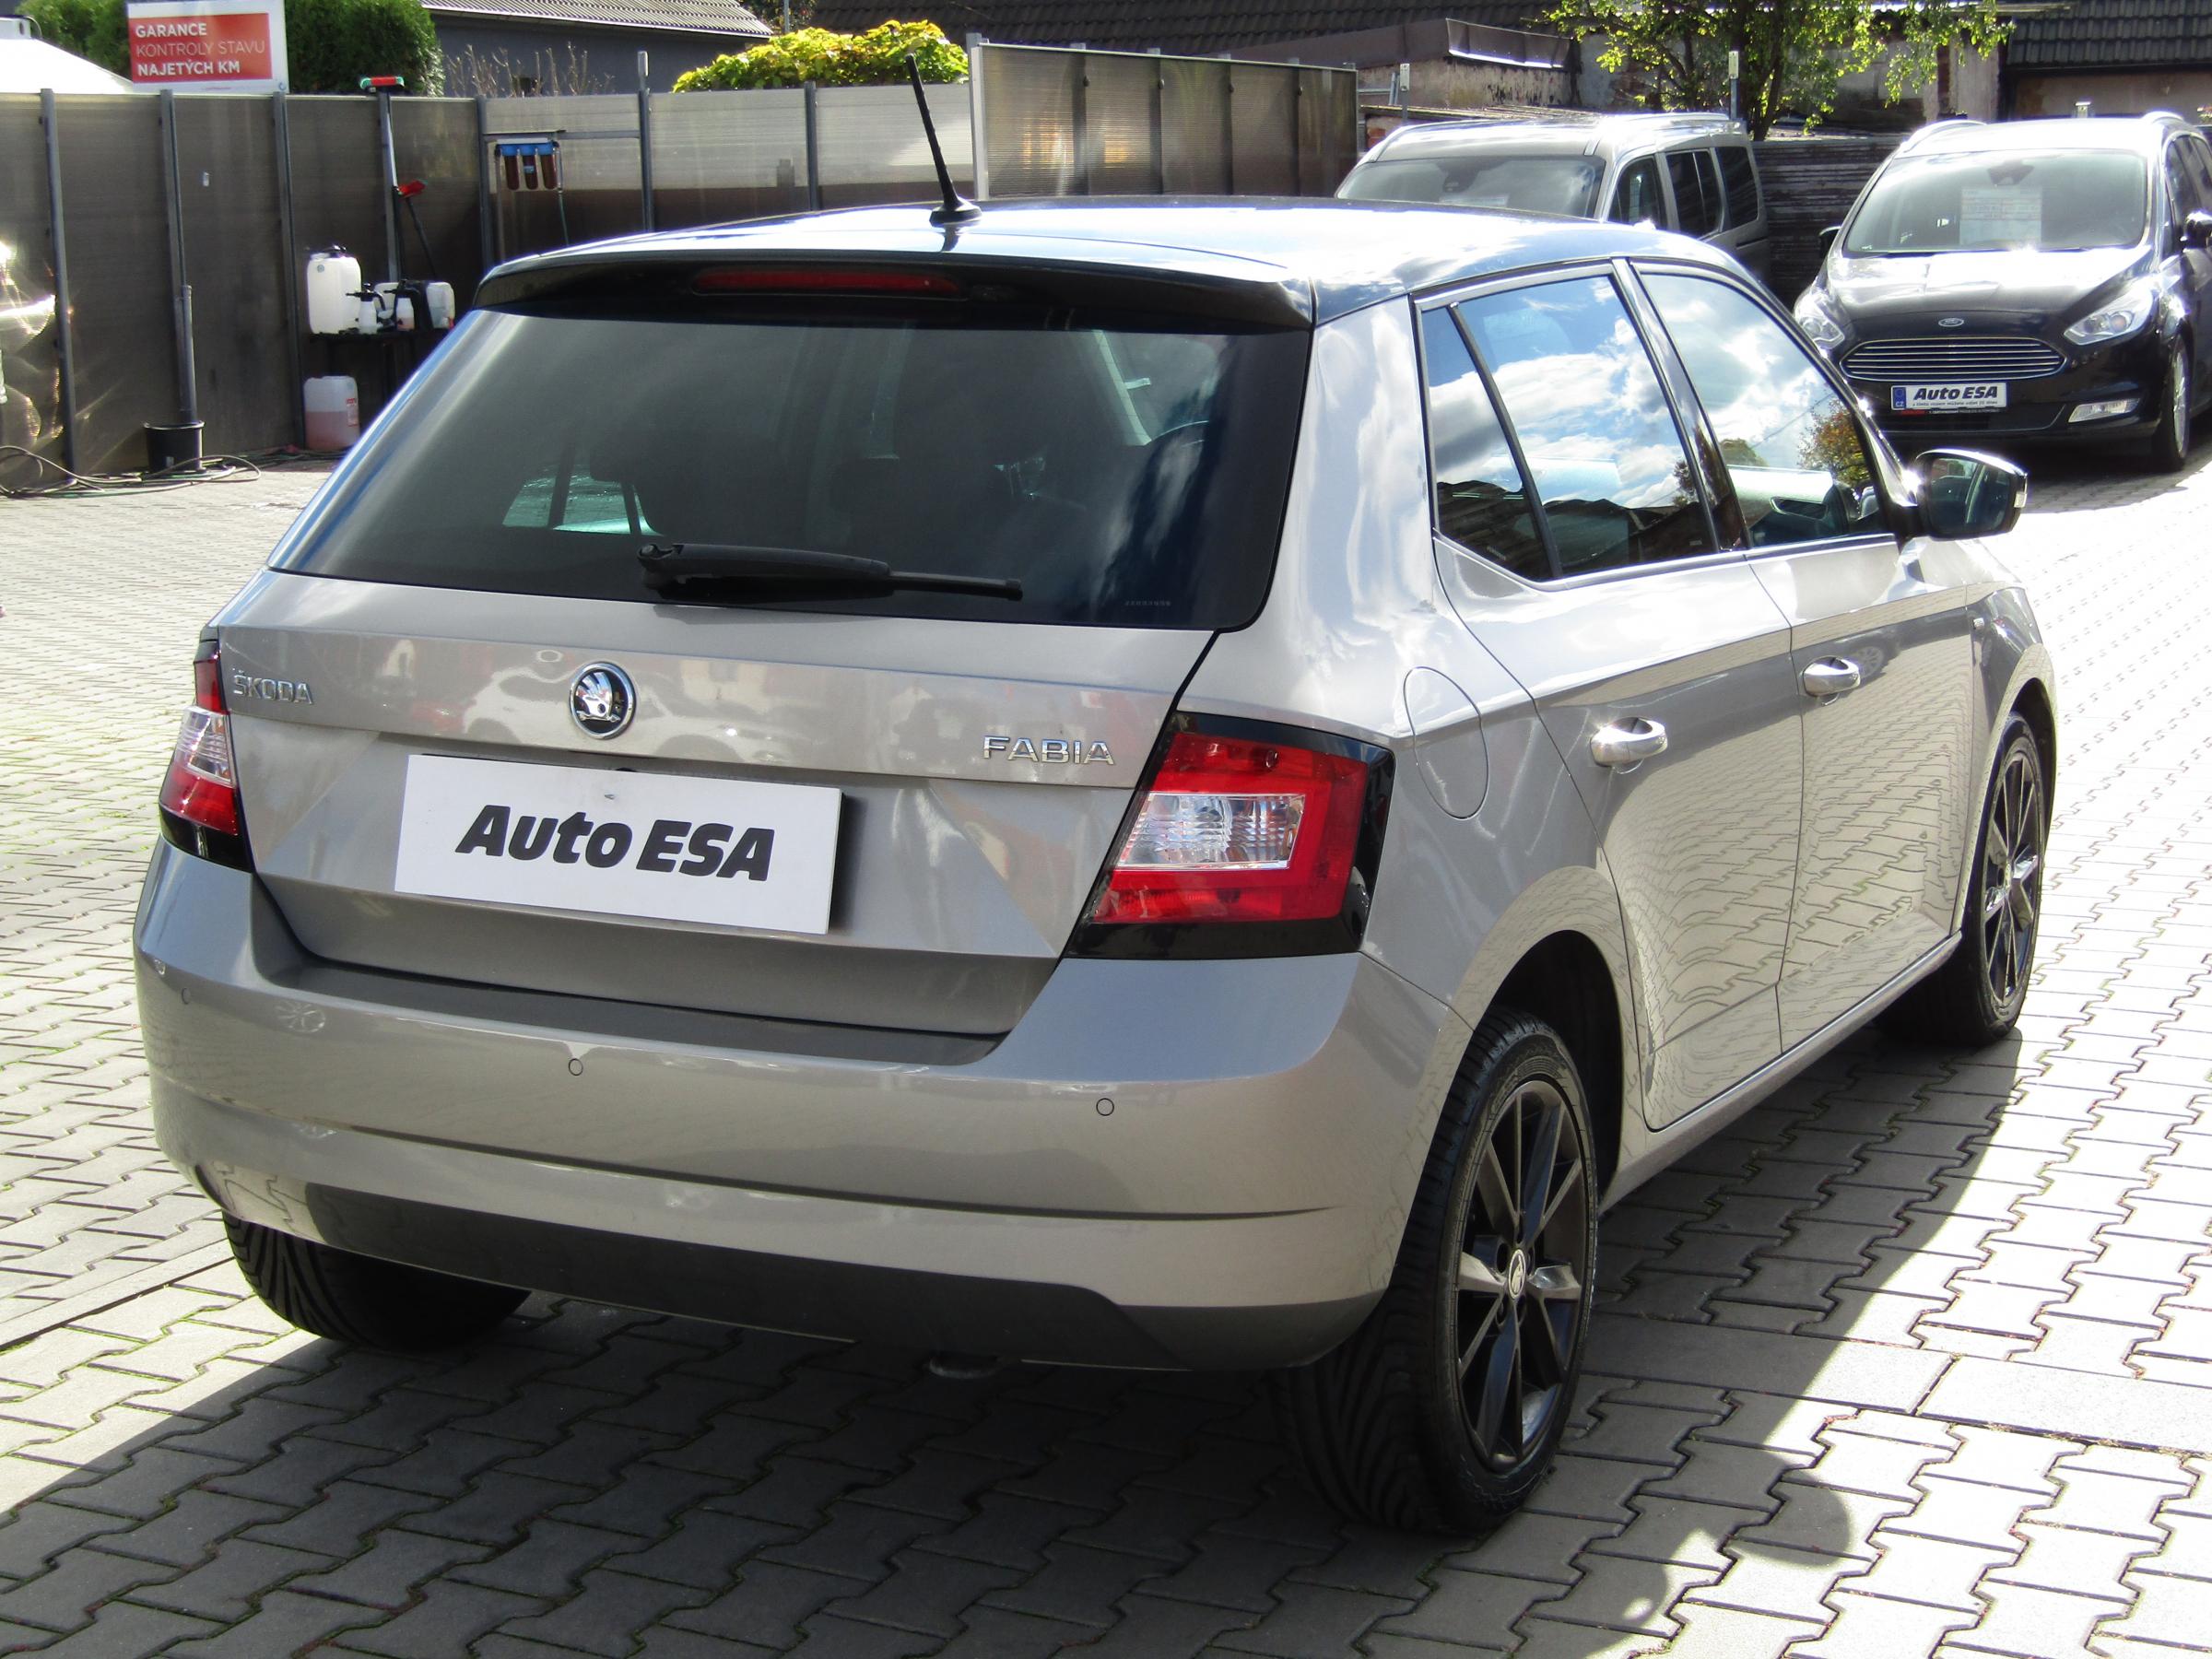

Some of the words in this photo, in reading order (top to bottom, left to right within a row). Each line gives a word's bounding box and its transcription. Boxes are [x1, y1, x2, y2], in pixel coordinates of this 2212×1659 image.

[135, 22, 207, 38] GARANCE
[137, 41, 216, 58] KONTROLY
[218, 40, 265, 55] STAVU
[138, 59, 214, 76] NAJETÝCH
[218, 60, 241, 75] KM
[1913, 387, 1960, 400] Auto
[1961, 386, 1998, 399] ESA
[232, 667, 314, 706] ŠKODA
[982, 735, 1115, 766] FABIA
[454, 804, 633, 868] Auto
[636, 818, 775, 882] ESA
